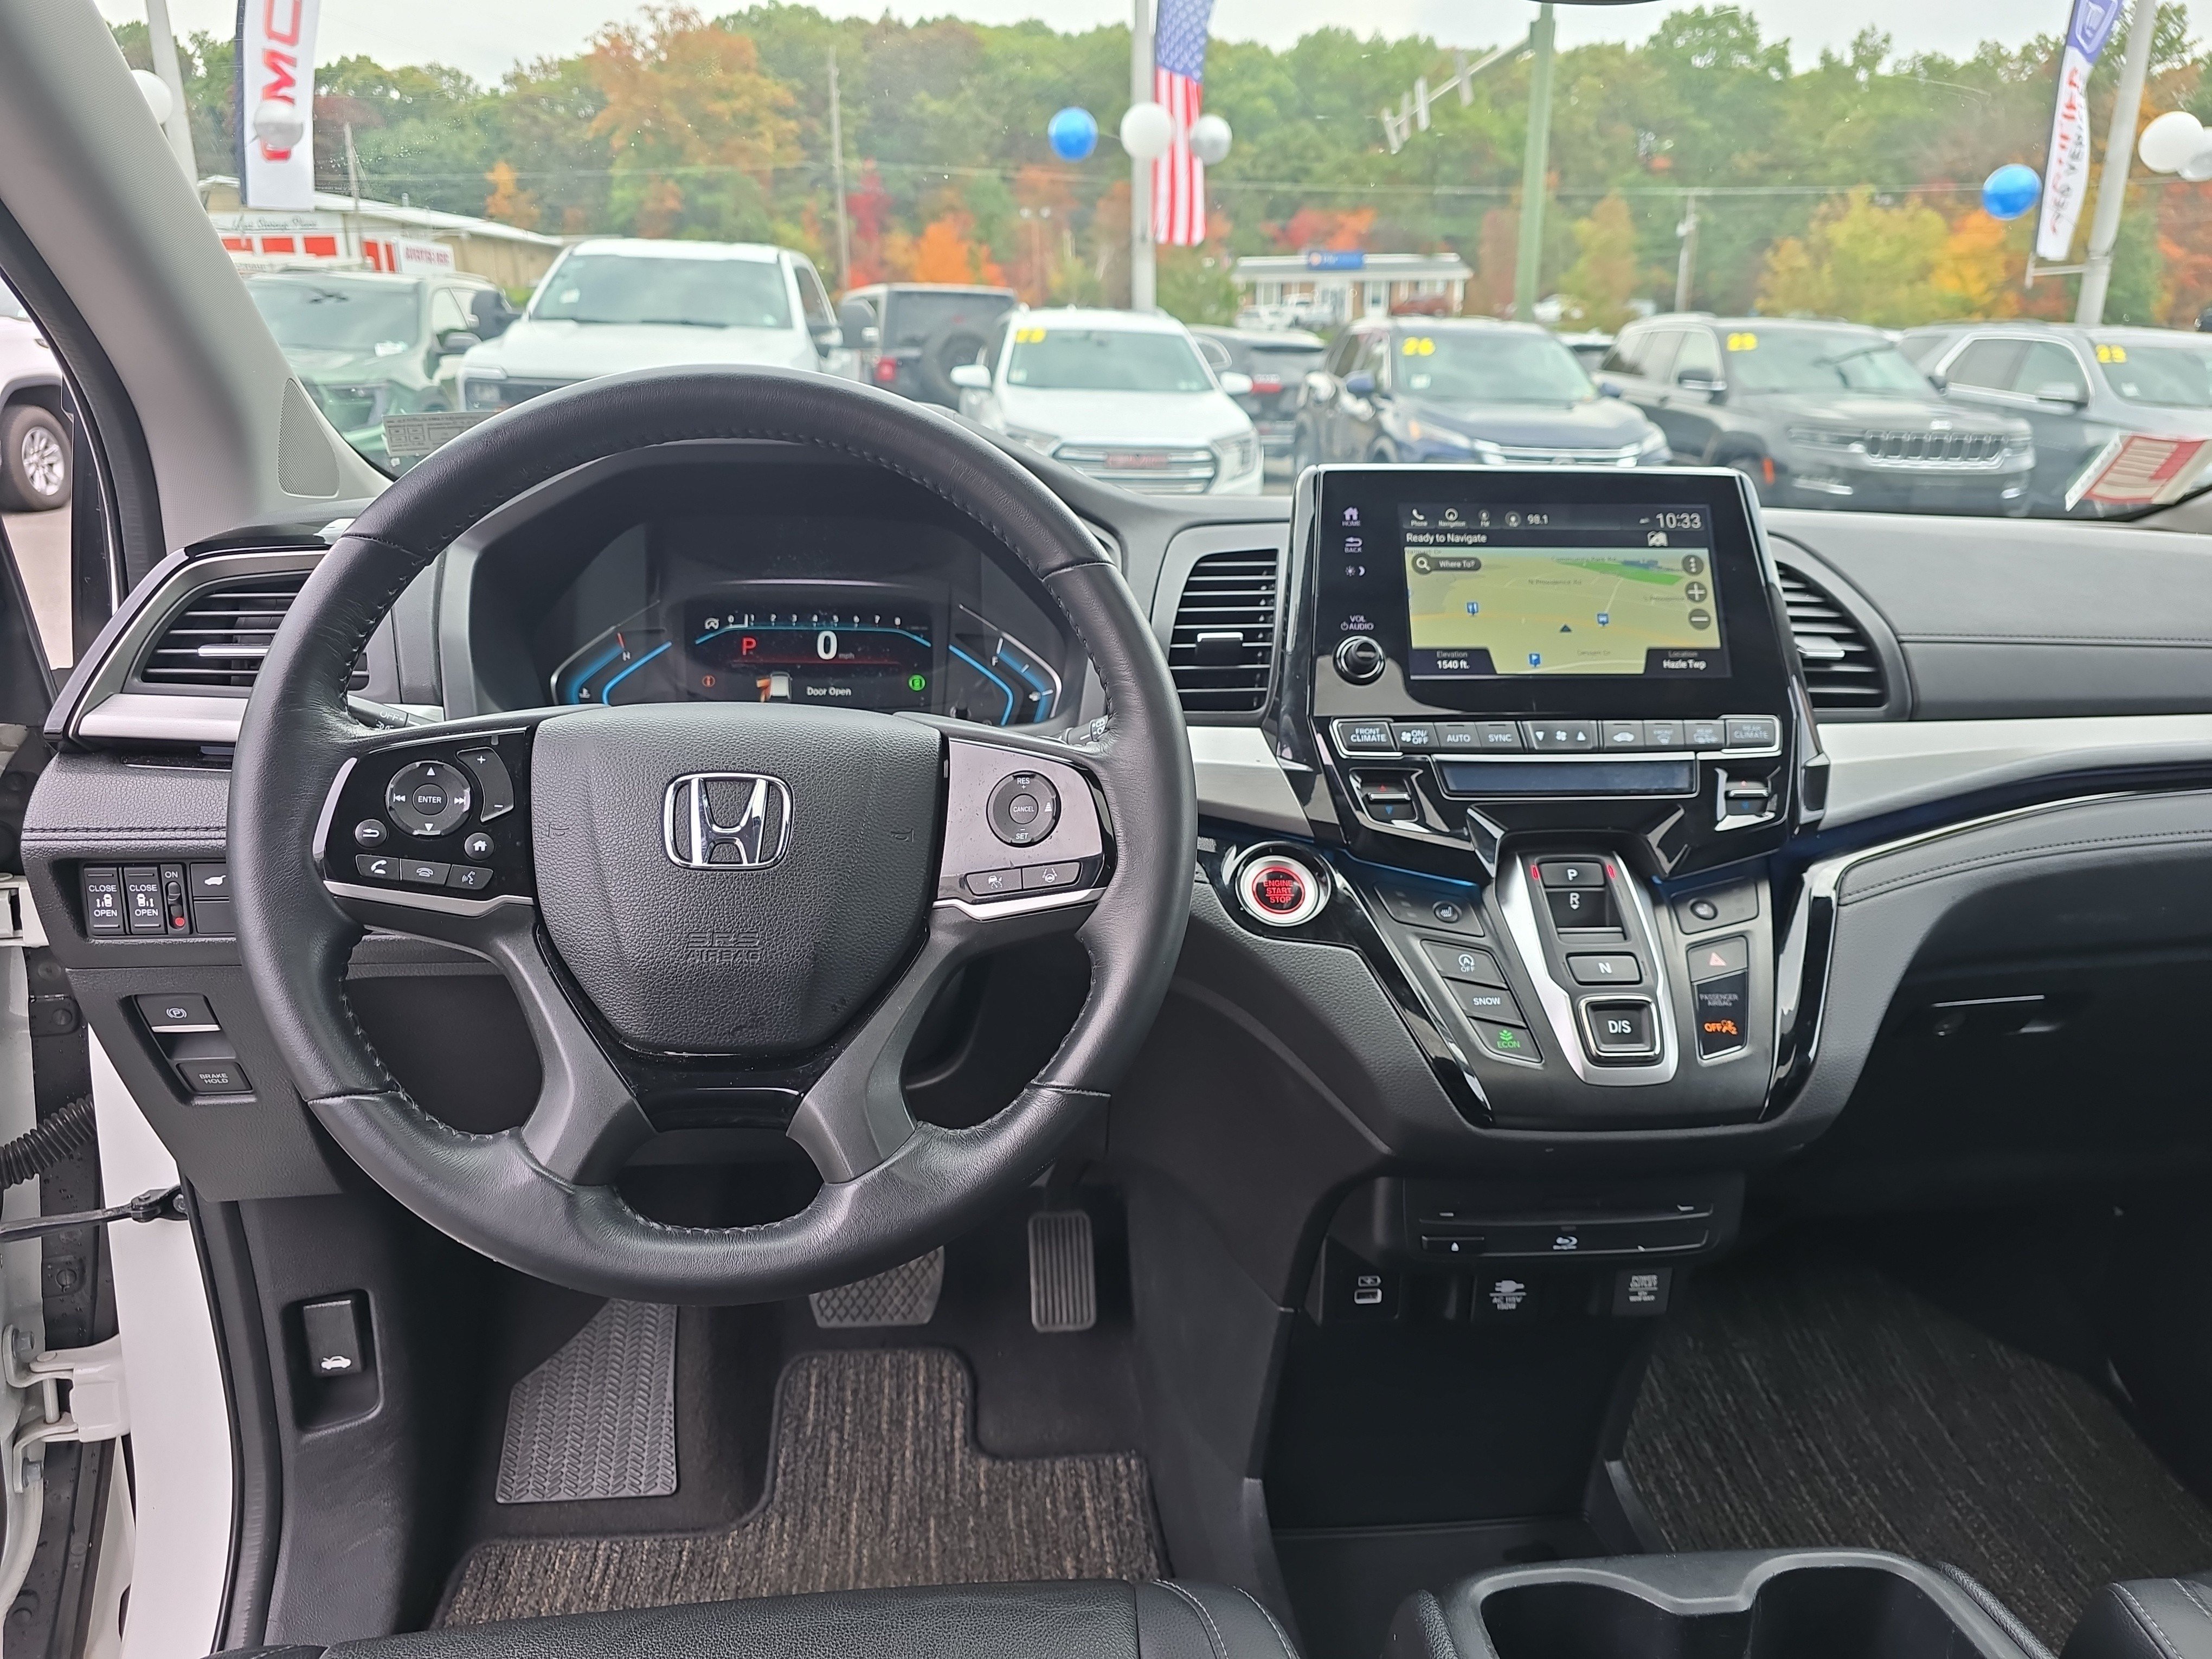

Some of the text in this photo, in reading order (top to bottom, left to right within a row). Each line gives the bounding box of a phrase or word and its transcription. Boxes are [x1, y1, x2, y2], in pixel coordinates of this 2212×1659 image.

[1656, 513, 1702, 529] 10:33
[1406, 533, 1488, 544] Ready to Navigate
[742, 638, 757, 656] P
[816, 630, 838, 660] 0
[1437, 659, 1470, 669] 1540 ft.
[1663, 660, 1706, 670] Hazle Twp
[807, 686, 852, 697] Door Open
[380, 710, 400, 722] OFF
[1351, 734, 1387, 743] CLIMATE
[1412, 736, 1429, 744] OFF
[1447, 734, 1471, 742] AUTO
[1488, 734, 1512, 742] SYNC
[1734, 731, 1770, 740] CLIMATE
[417, 795, 442, 804] ENTER
[165, 871, 178, 879] ON
[1567, 869, 1578, 882] P
[88, 884, 117, 892] CLOSE
[129, 884, 158, 892] CLOSE
[1569, 892, 1581, 905] R
[94, 910, 118, 918] OPEN
[134, 909, 159, 917] OPEN
[687, 931, 759, 947] SRS
[686, 950, 760, 963] AIRBAG
[1598, 962, 1612, 974] N
[1473, 996, 1501, 1006] SNOW
[1607, 1019, 1632, 1034] D/S
[1704, 1023, 1722, 1032] OFF
[1496, 1040, 1521, 1049] ECON
